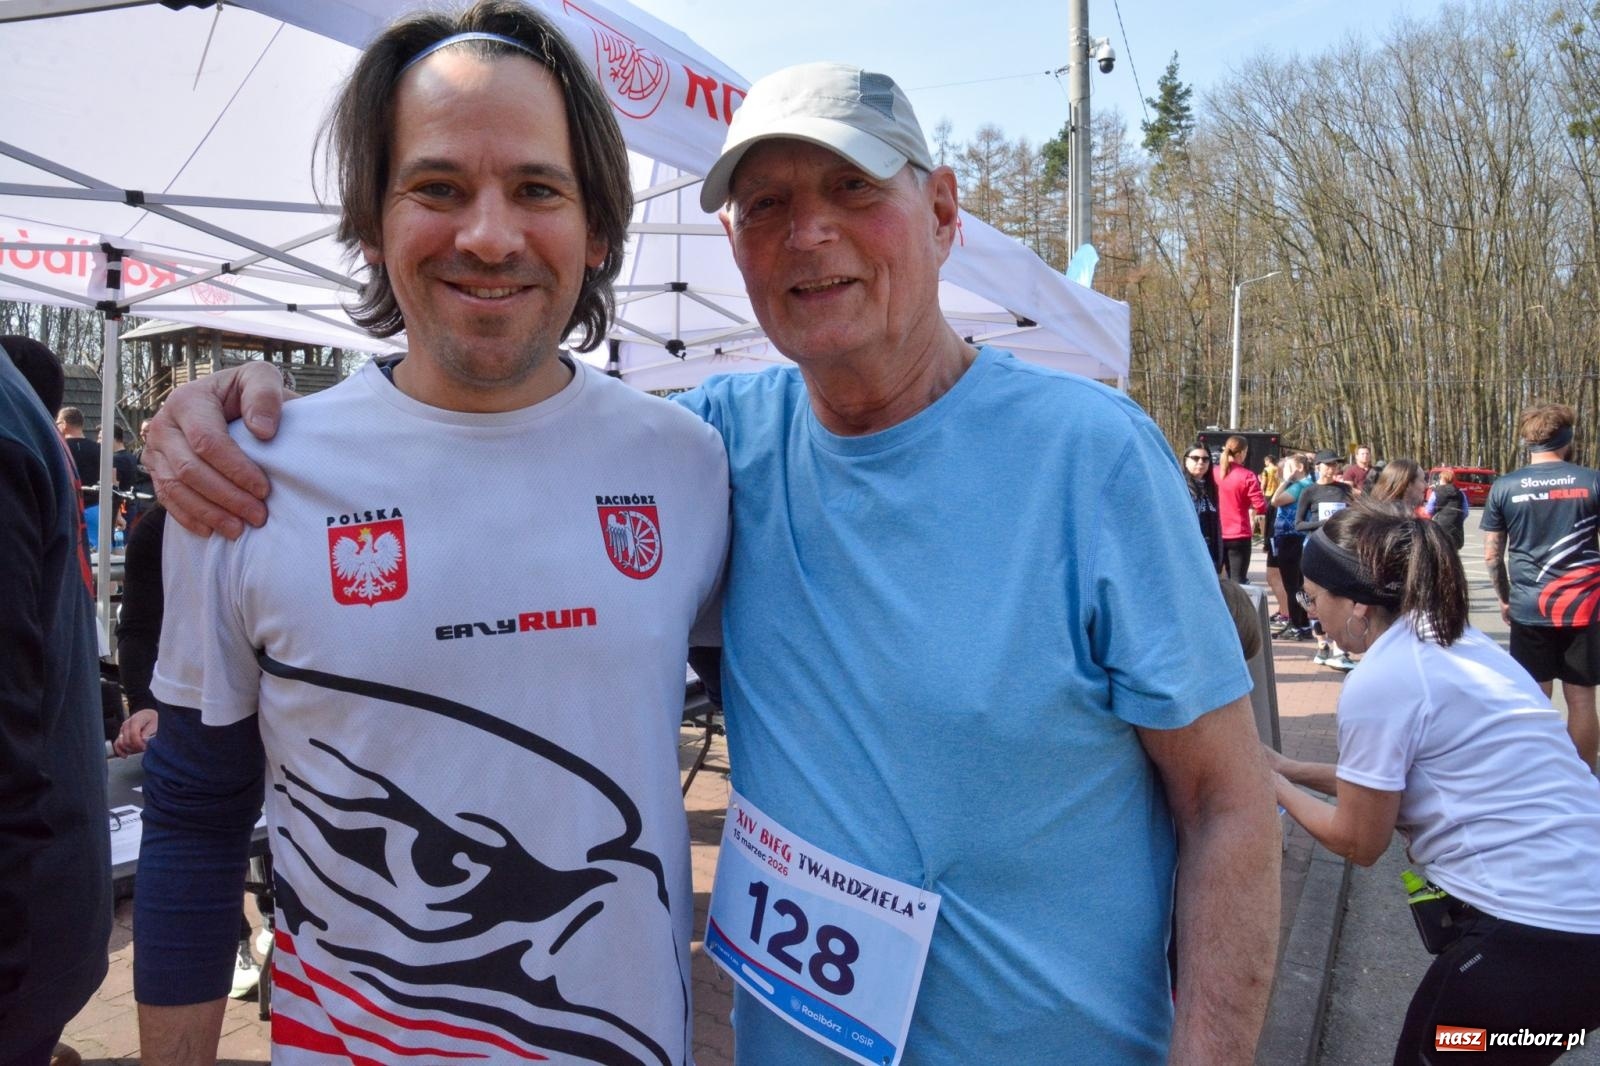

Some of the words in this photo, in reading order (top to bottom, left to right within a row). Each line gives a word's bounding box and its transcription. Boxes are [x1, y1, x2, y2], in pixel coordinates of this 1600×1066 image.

[595, 493, 656, 505] RACIBÓRZ
[1520, 475, 1577, 488] Sławomir
[326, 507, 403, 526] POLSKA
[733, 828, 741, 841] 15
[741, 837, 767, 861] marzec
[767, 855, 789, 876] 2026
[737, 809, 758, 834] XIV
[760, 828, 792, 863] BIEG
[798, 852, 915, 918] TWARDZIELA
[748, 881, 860, 996] 128
[801, 1004, 843, 1034] Racibórz
[851, 1031, 875, 1048] OSiR
